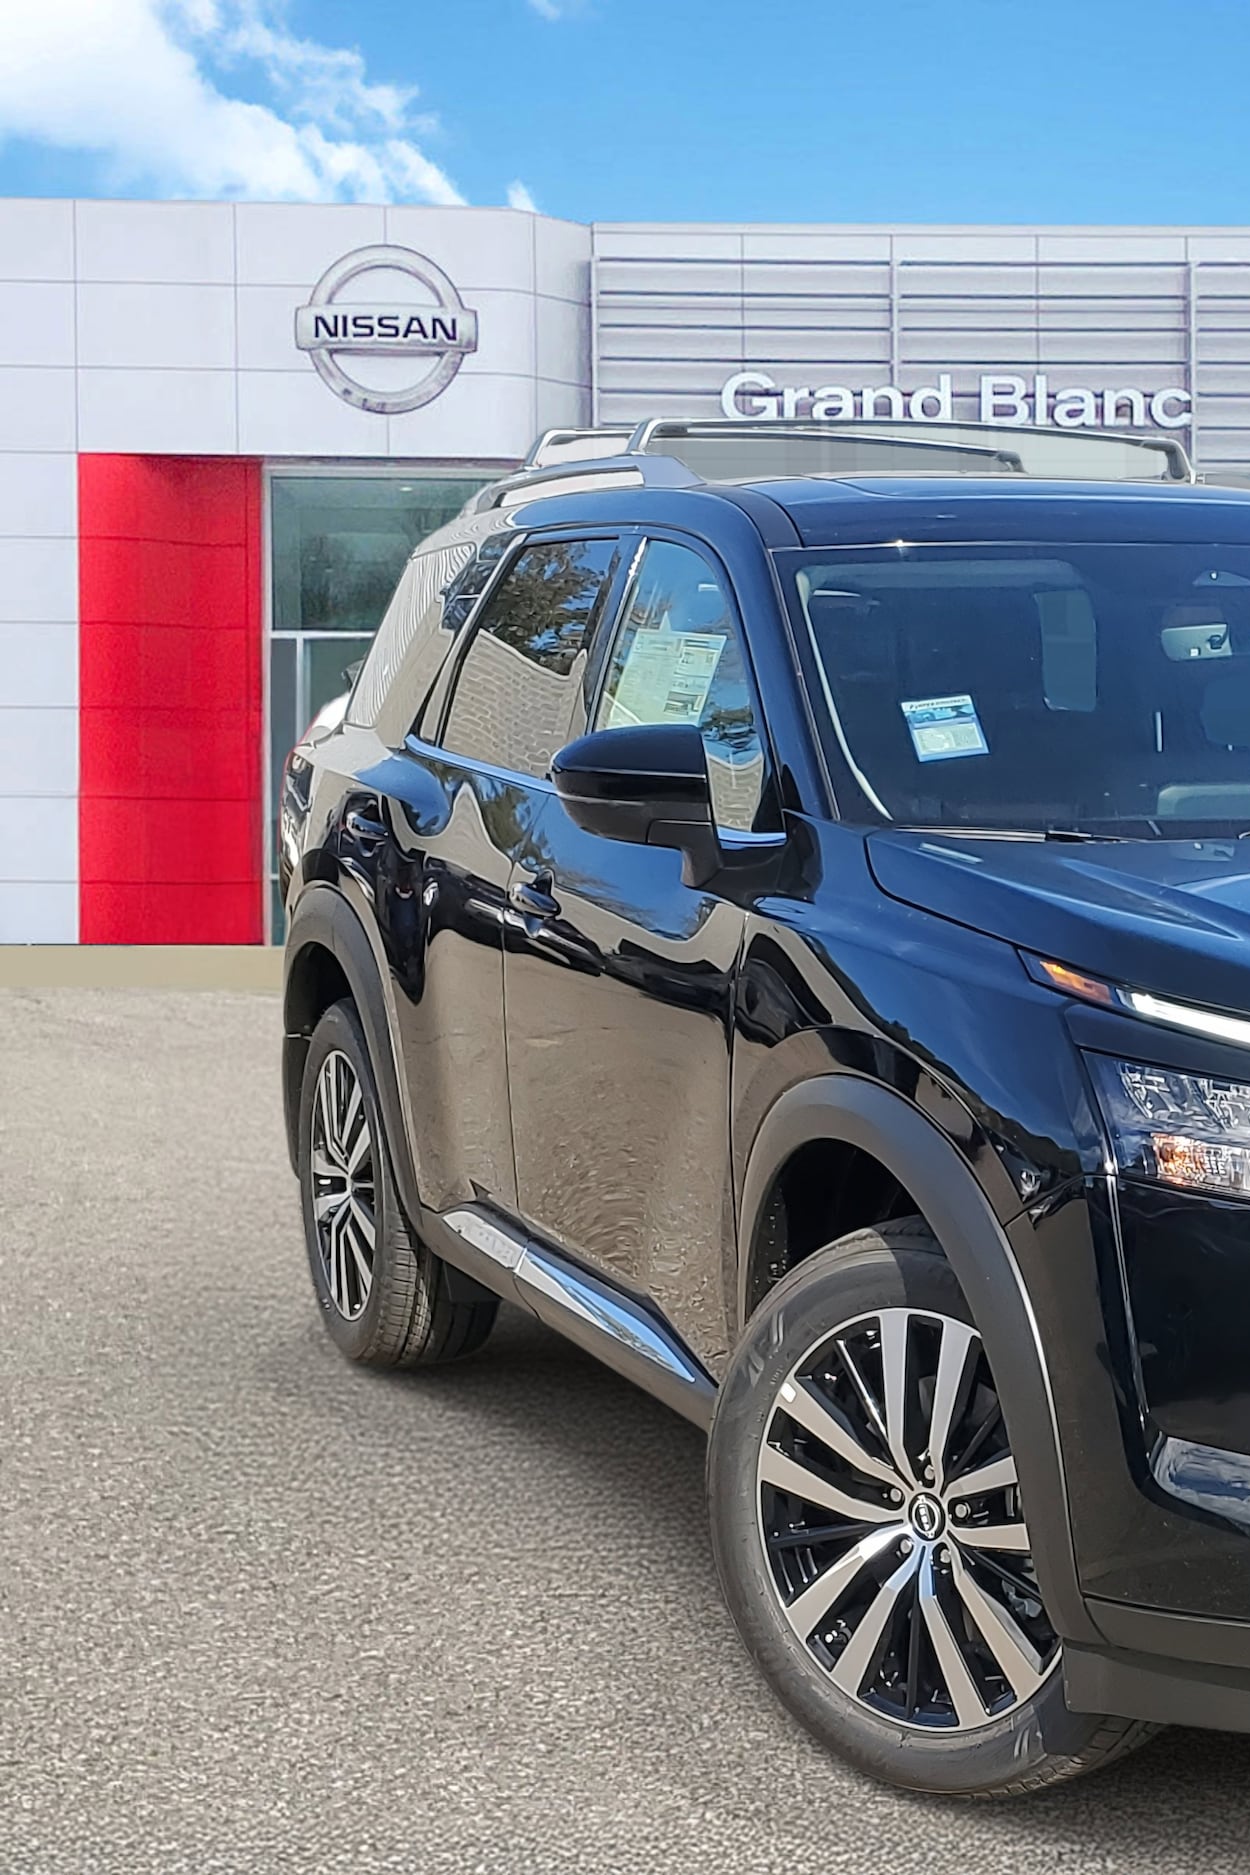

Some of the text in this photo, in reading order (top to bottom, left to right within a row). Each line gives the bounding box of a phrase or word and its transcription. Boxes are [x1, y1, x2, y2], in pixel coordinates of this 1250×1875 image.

[314, 315, 457, 341] NISSAN
[721, 371, 1193, 428] Grand Blanc
